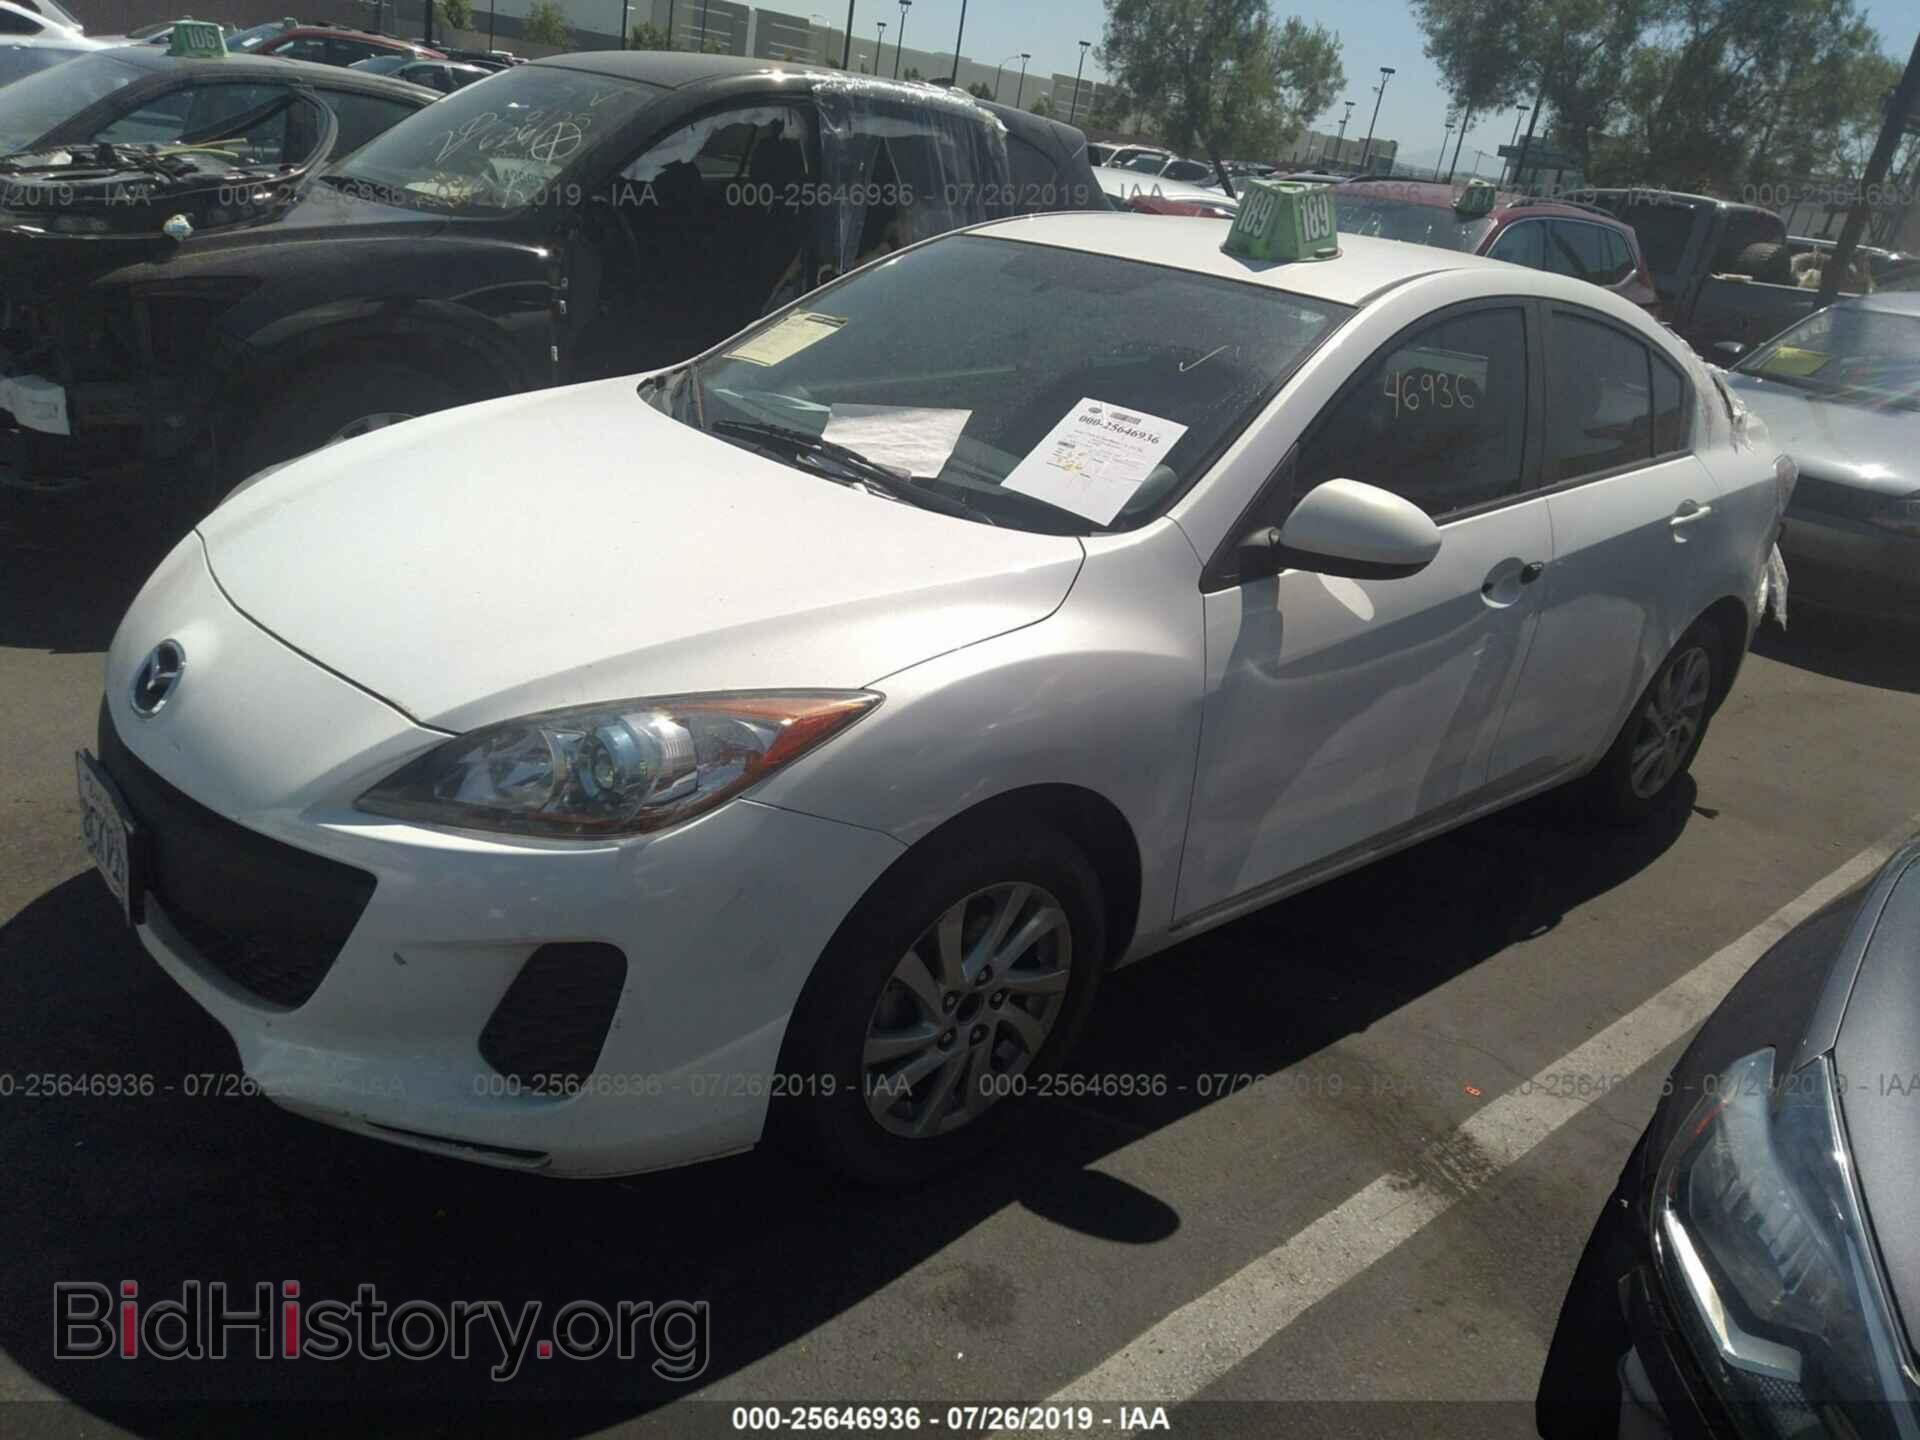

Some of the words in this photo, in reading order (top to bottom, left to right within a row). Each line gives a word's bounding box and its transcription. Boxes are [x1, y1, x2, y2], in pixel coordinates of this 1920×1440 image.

[1237, 188, 1276, 238] 189
[1301, 193, 1330, 241] 189
[1384, 371, 1474, 417] 46936
[1079, 415, 1160, 444] 000-25646936
